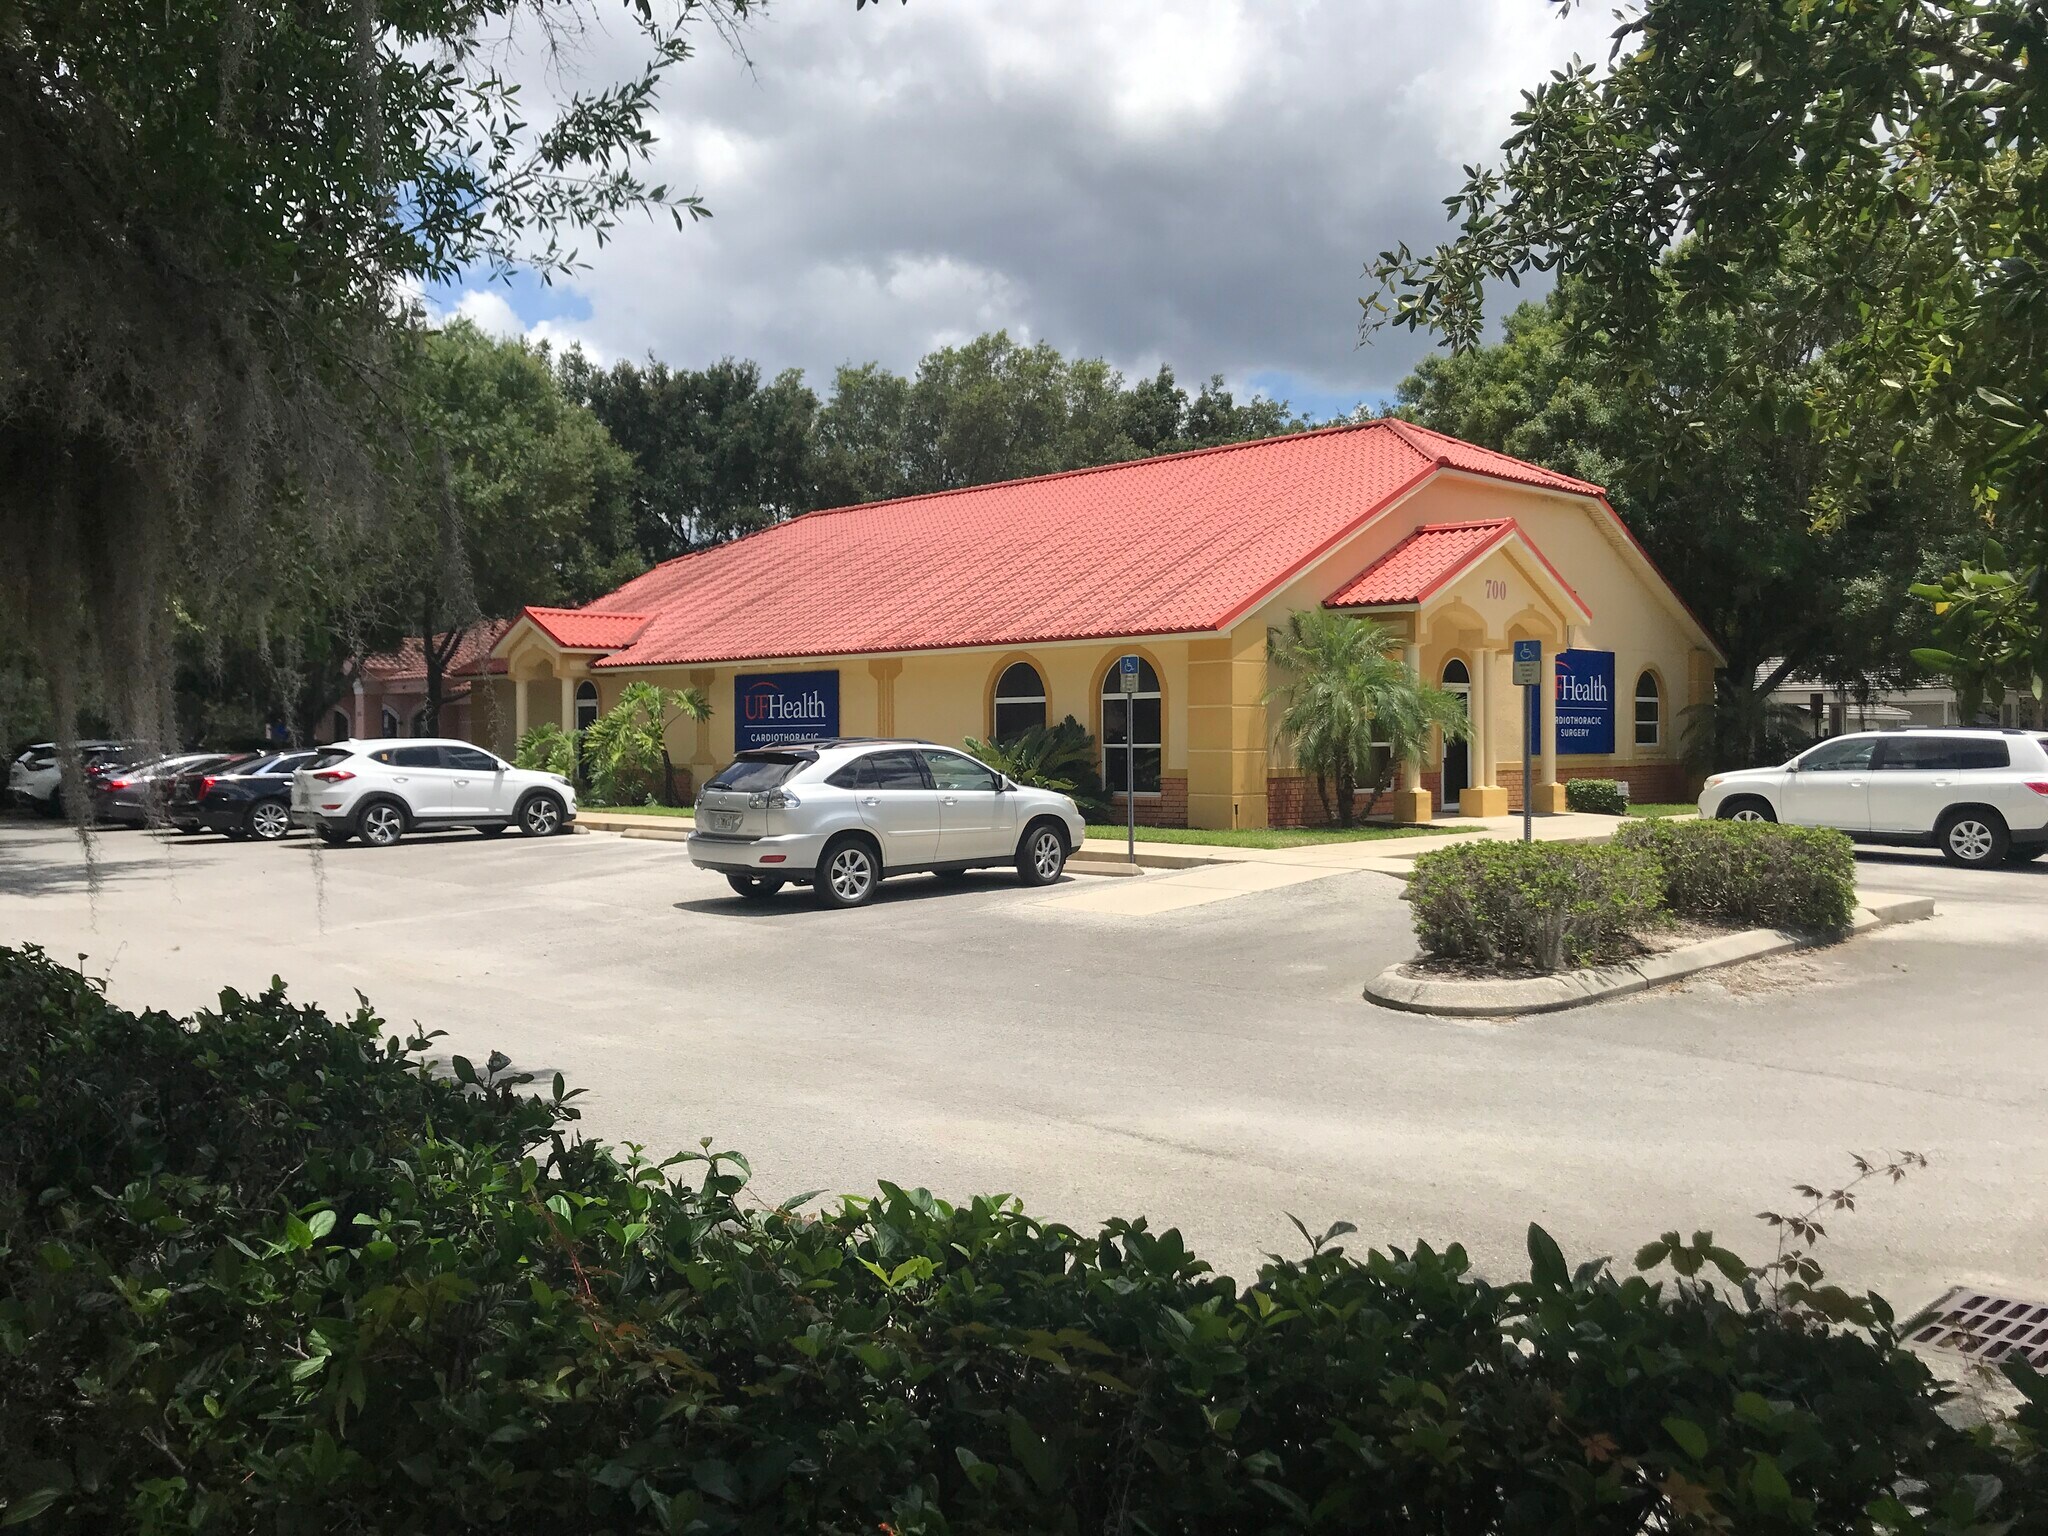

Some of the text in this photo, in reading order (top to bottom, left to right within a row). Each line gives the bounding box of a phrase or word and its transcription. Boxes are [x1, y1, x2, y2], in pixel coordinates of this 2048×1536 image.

[1485, 579, 1507, 600] 700
[1555, 674, 1608, 702] FHealth
[1555, 716, 1602, 725] RDIOTHORACIC
[1560, 728, 1590, 737] SURGERY
[750, 733, 819, 742] CARDIOTHORACIC
